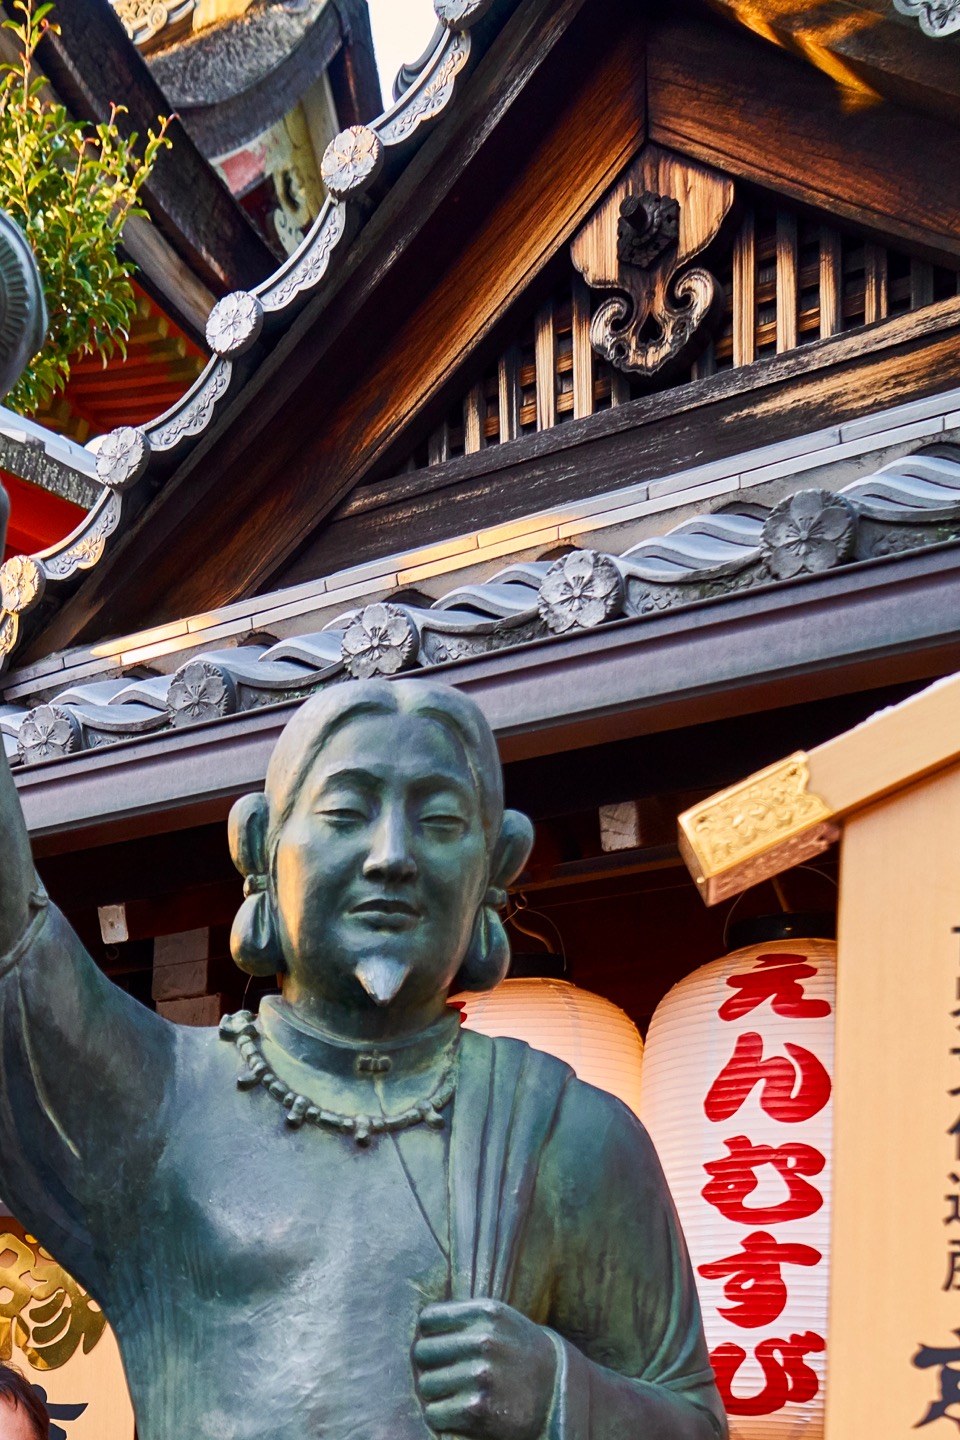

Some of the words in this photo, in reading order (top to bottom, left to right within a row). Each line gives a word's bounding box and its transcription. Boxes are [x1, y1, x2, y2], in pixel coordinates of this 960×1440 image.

[698, 953, 832, 1416] えんむすび
